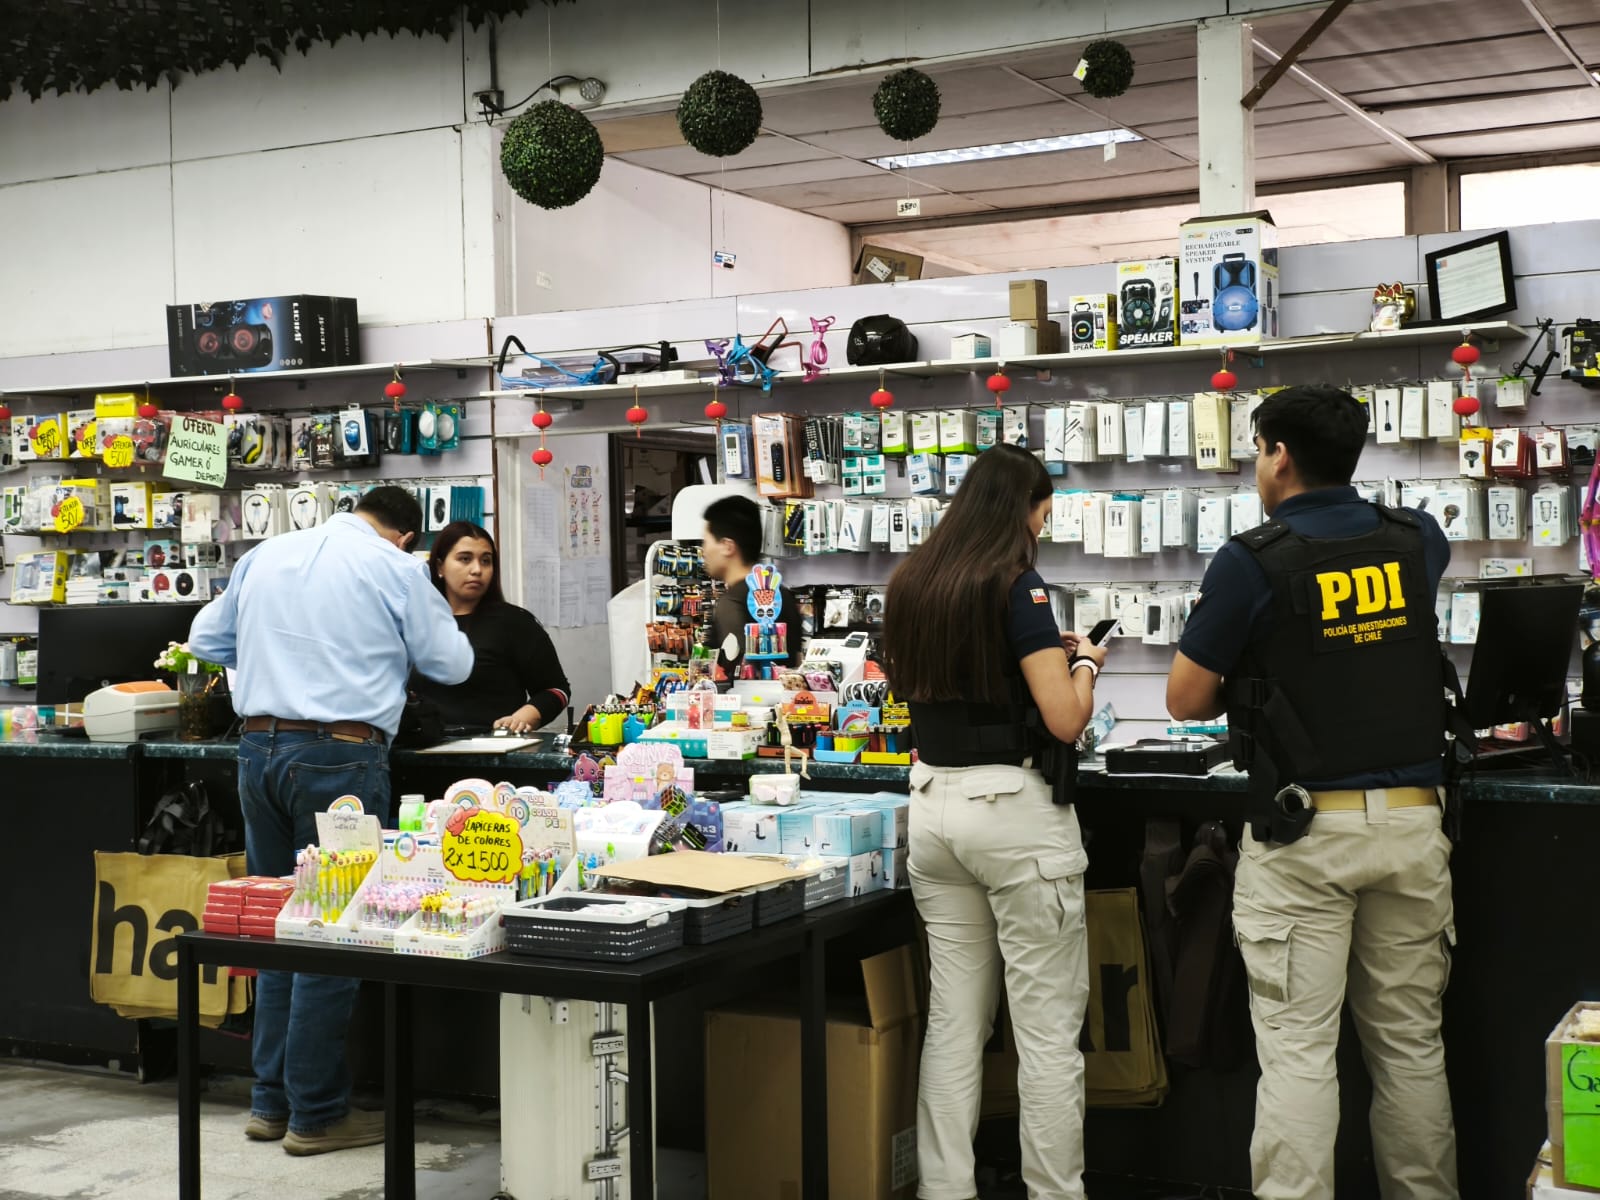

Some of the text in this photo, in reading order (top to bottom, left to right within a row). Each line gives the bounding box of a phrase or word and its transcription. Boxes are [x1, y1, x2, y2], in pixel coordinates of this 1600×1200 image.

[1185, 240, 1241, 251] RECHARGEABLE
[1119, 331, 1174, 344] SPEAKER
[183, 417, 216, 437] OFERTA
[316, 443, 330, 453] X24
[170, 451, 204, 469] GAMER
[1315, 561, 1406, 621] PDI
[1323, 616, 1408, 638] POLICÍA DE INVESTIGACIONES
[1353, 630, 1382, 644] DE CHILE
[510, 806, 559, 820] 10 COLOR
[457, 835, 471, 846] DE
[96, 880, 219, 985] ha
